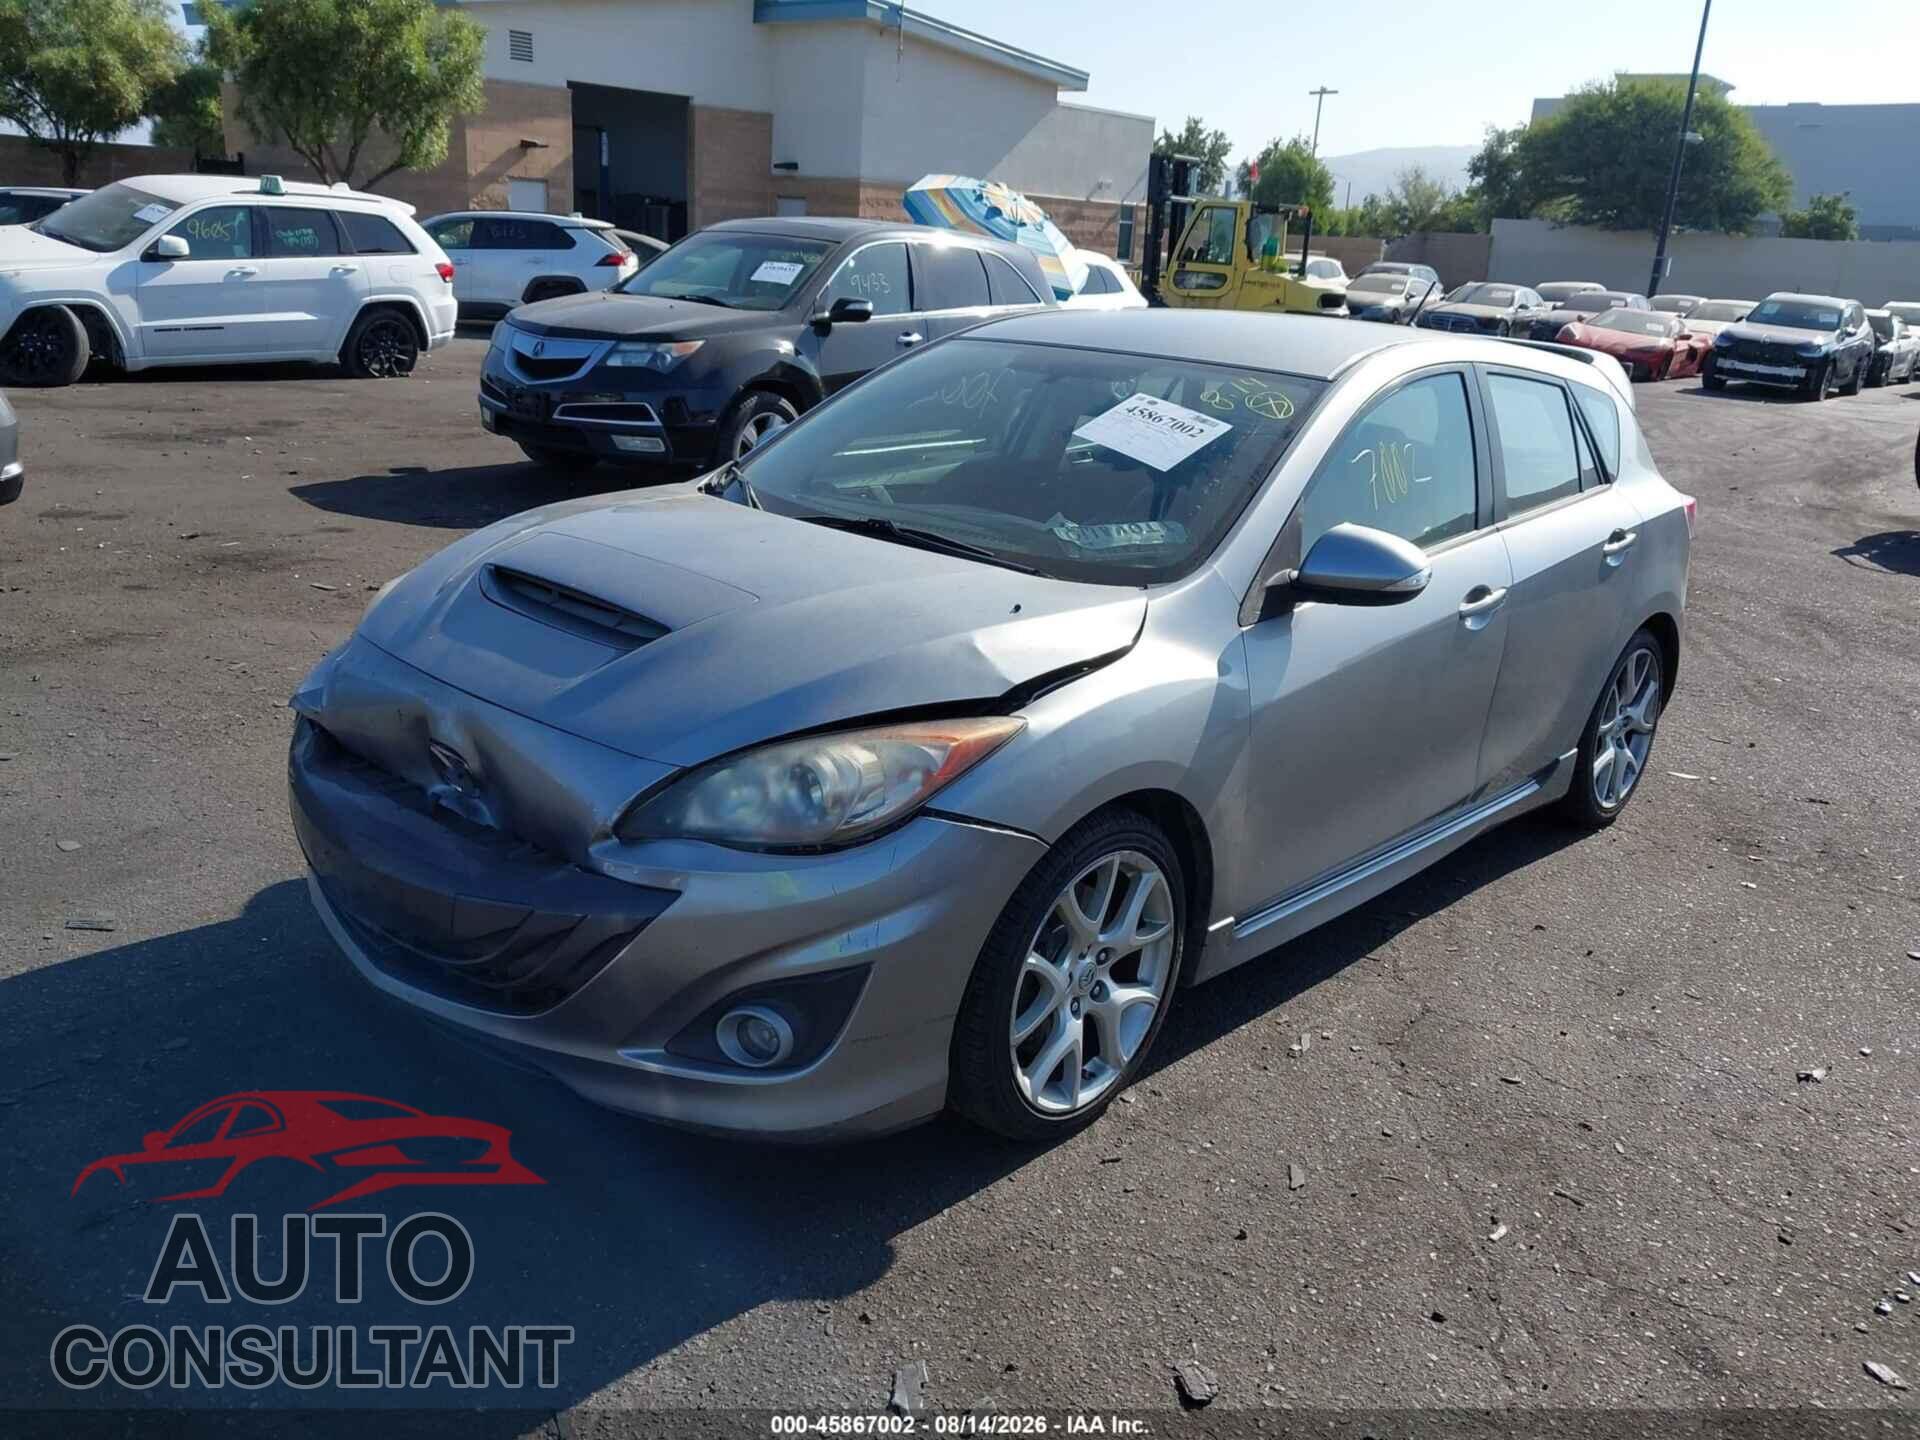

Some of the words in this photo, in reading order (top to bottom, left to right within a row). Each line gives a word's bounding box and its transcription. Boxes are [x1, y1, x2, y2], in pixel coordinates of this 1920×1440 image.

[850, 271, 890, 294] 9433
[1125, 404, 1205, 438] 45867002
[1351, 440, 1433, 511] 7002
